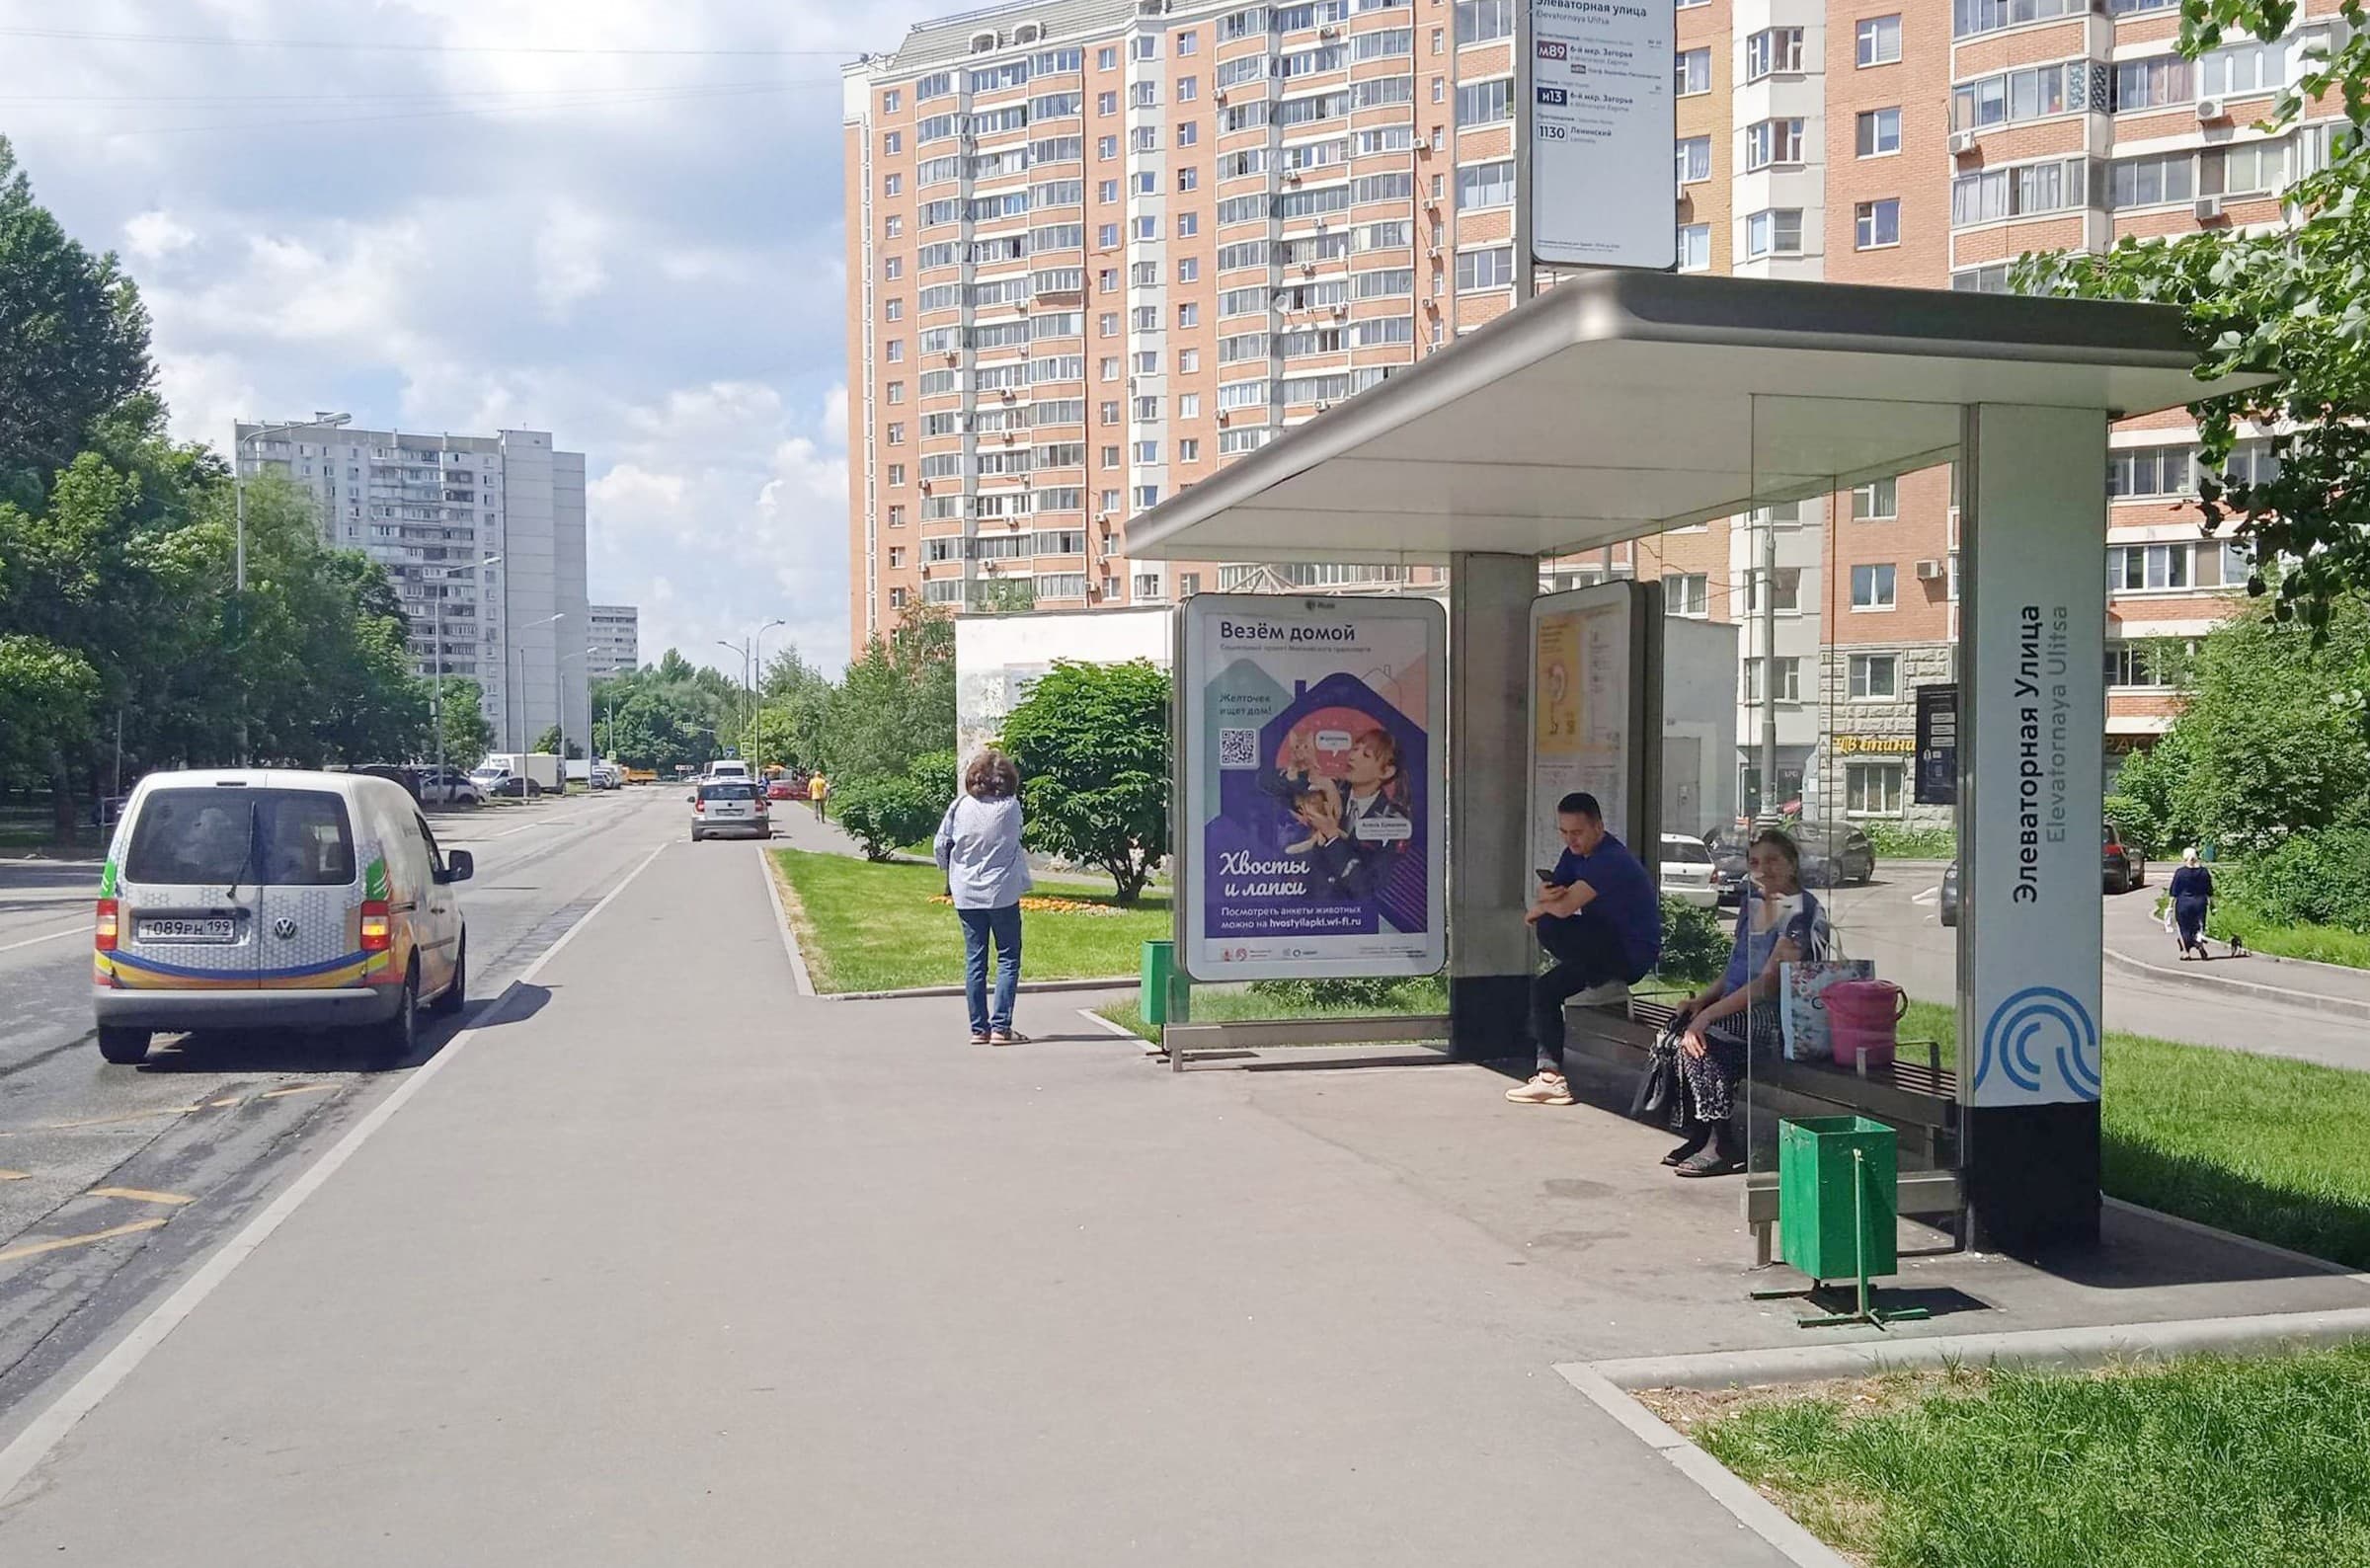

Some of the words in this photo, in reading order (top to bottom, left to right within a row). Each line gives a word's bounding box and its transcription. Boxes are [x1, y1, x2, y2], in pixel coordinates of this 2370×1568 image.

[1613, 5, 1647, 18] улица
[1540, 125, 1565, 139] 1130
[1221, 621, 1284, 640] Везём
[1290, 625, 1355, 642] домой
[2047, 606, 2068, 675] Ulitsa
[2014, 605, 2043, 697] Улица
[1246, 707, 1272, 716] дом!
[2047, 685, 2070, 842] Elevatornaya
[2014, 707, 2043, 903] Элеваторная
[1220, 850, 1310, 876] Хвосты
[1224, 883, 1239, 897] и
[1242, 882, 1307, 897] лапки
[1222, 906, 1280, 918] Посмотреть
[1315, 905, 1362, 915] животных
[1221, 920, 1254, 929] можно
